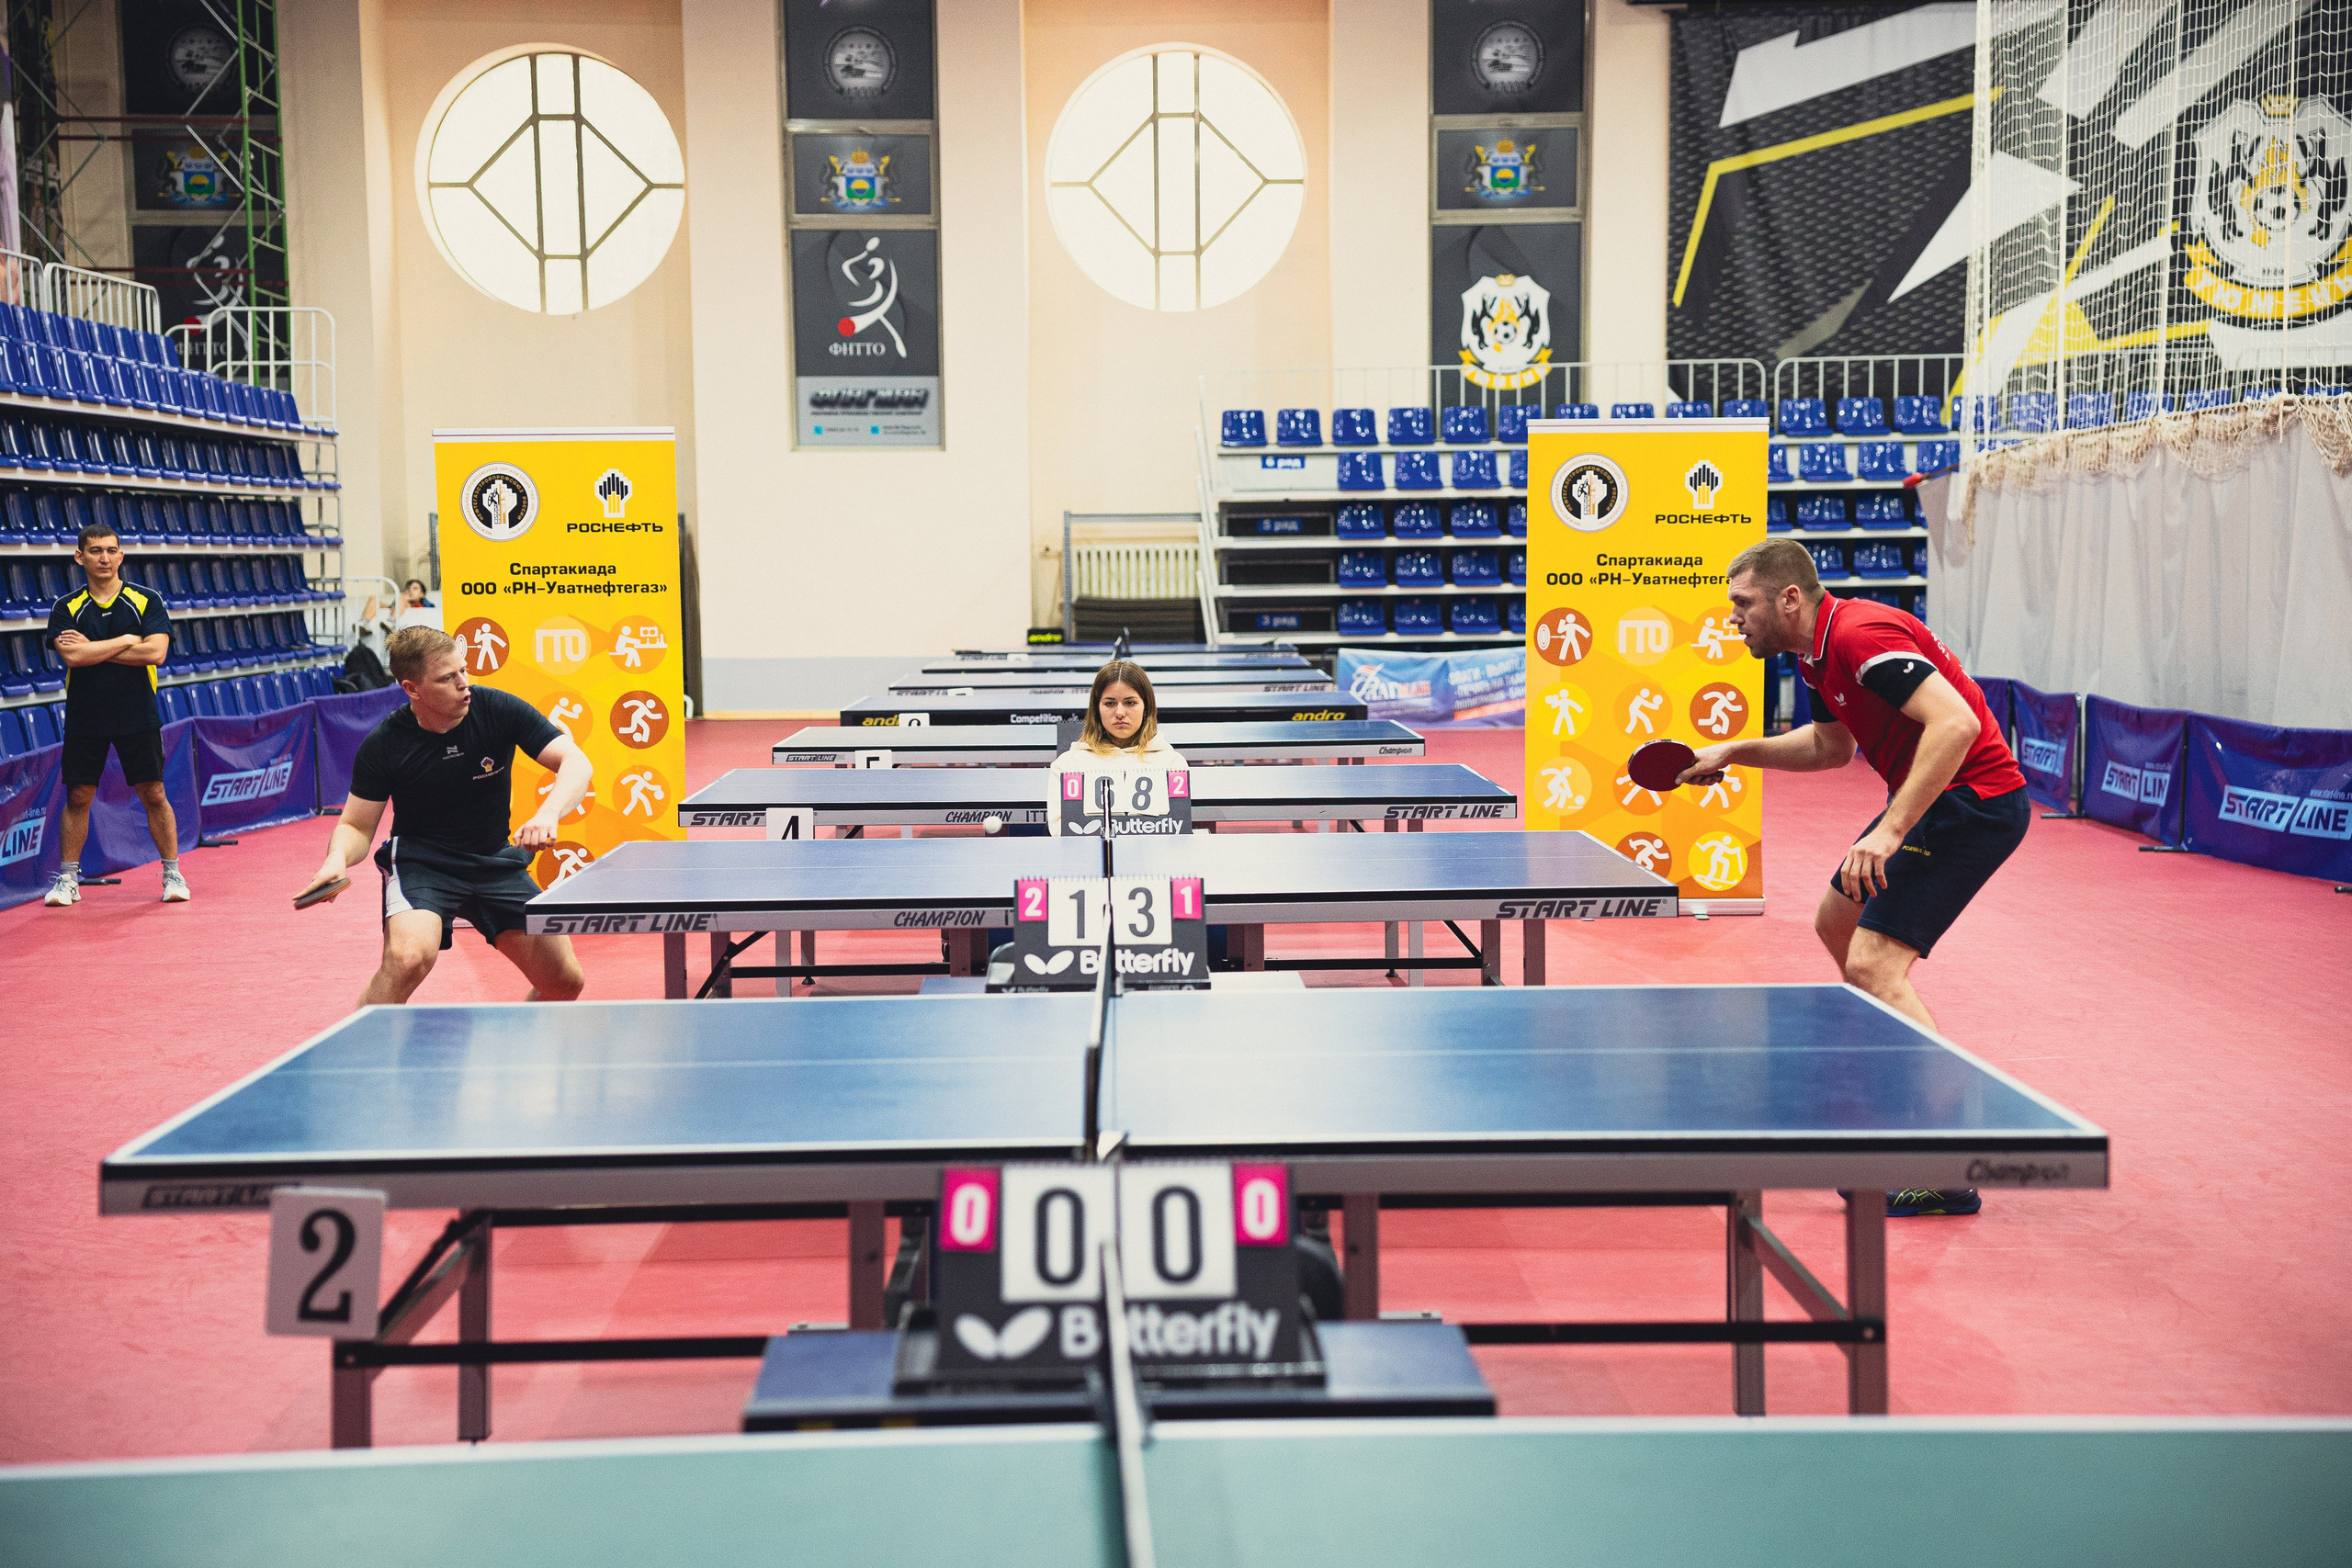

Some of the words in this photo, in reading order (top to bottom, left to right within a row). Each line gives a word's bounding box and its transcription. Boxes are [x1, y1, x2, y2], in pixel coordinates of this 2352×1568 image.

[828, 342, 887, 357] ФНТТО
[516, 495, 527, 521] РОССИИ
[566, 522, 663, 533] РОСНЕФТЬ
[1655, 513, 1752, 525] РОСНЕФТЬ
[509, 561, 617, 579] Спартакиада
[1596, 553, 1703, 570] Спартакиада
[460, 581, 498, 595] ООО
[1545, 572, 1584, 586] ООО
[535, 627, 587, 663] ГТО
[1618, 619, 1669, 654] ГТО
[862, 715, 899, 727] and
[1010, 713, 1062, 725] Competition
[1292, 709, 1346, 722] andro
[1379, 746, 1413, 757] Champion
[207, 773, 263, 799] START
[264, 766, 288, 791] LINE
[2105, 766, 2138, 798] START
[1131, 776, 1153, 811] 8
[1172, 775, 1185, 795] 2
[690, 811, 766, 826] START
[1384, 805, 1458, 819] START
[1459, 805, 1505, 818] LINE
[2223, 791, 2295, 825] START
[2294, 803, 2349, 833] LINE
[2, 824, 41, 859] LINE
[1902, 845, 1931, 856] FORWAD
[893, 909, 986, 927] CHAMPION
[1024, 886, 1043, 917] 2
[1069, 889, 1086, 939] 1
[1128, 886, 1156, 938] 3
[1180, 886, 1193, 915] 1
[1496, 900, 1598, 919] START
[1600, 898, 1662, 917] LINE
[542, 914, 646, 933] START
[649, 912, 714, 932] LINE
[1080, 948, 1195, 976] Btterfly
[951, 1183, 990, 1246] 0
[1035, 1186, 1086, 1286] 0
[1152, 1185, 1203, 1284] 0
[1242, 1178, 1281, 1240] 0
[297, 1208, 356, 1324] 2
[1058, 1300, 1281, 1361] Btterfly
